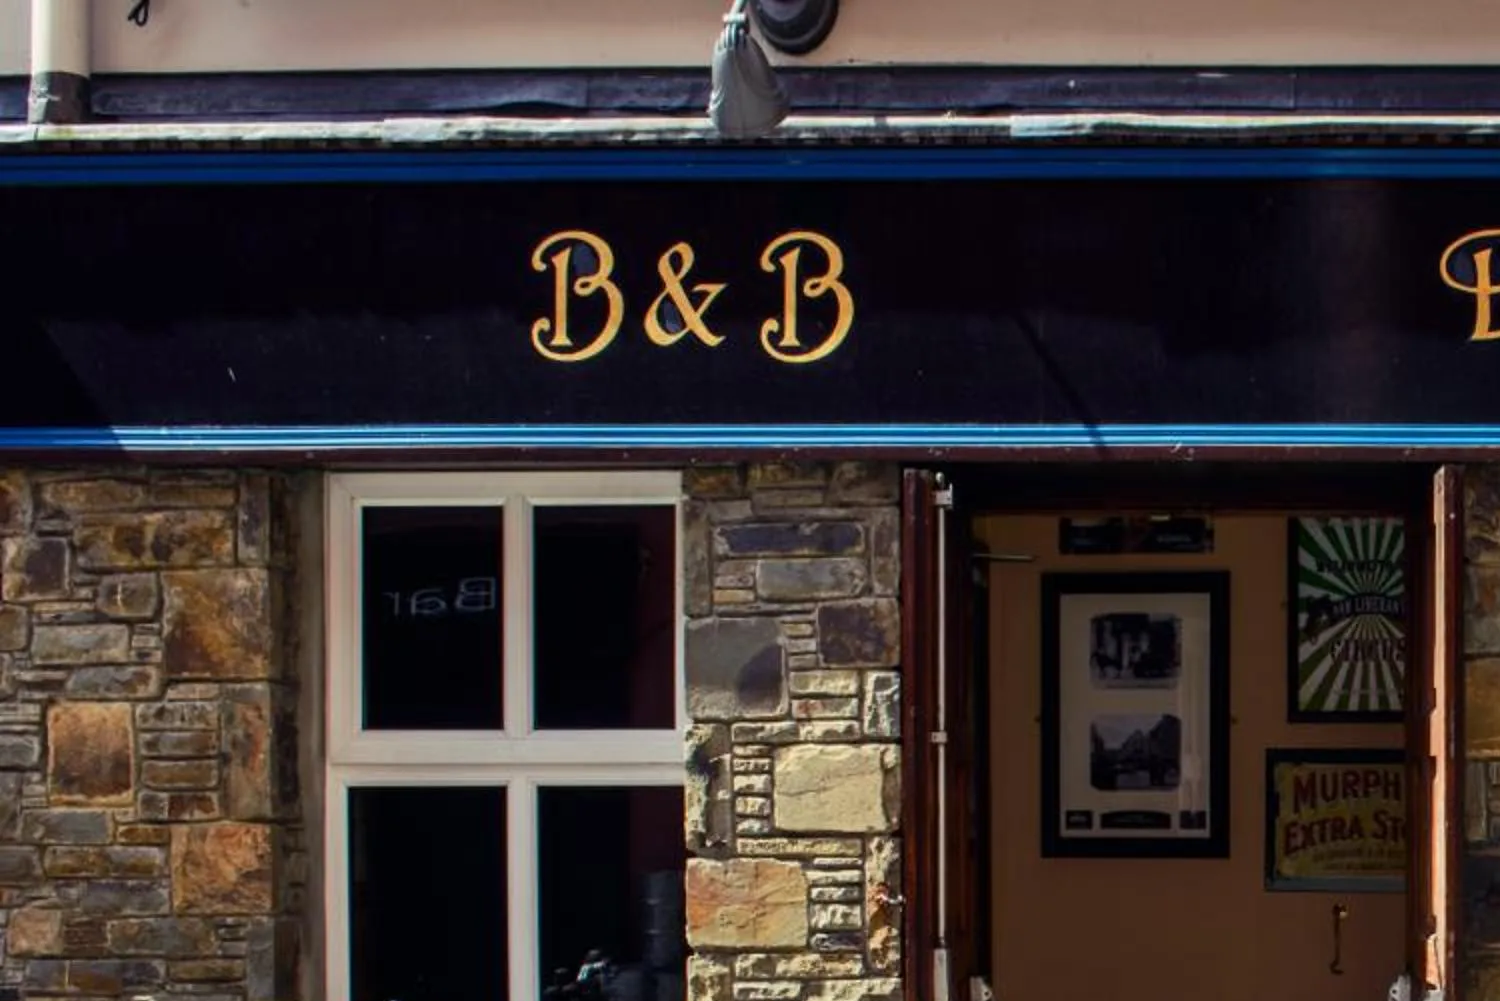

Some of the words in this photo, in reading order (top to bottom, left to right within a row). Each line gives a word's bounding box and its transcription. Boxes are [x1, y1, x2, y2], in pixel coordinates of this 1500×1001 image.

[532, 231, 624, 363] B
[643, 242, 725, 348] &
[760, 231, 855, 364] B
[1285, 816, 1364, 856] EXTRA
